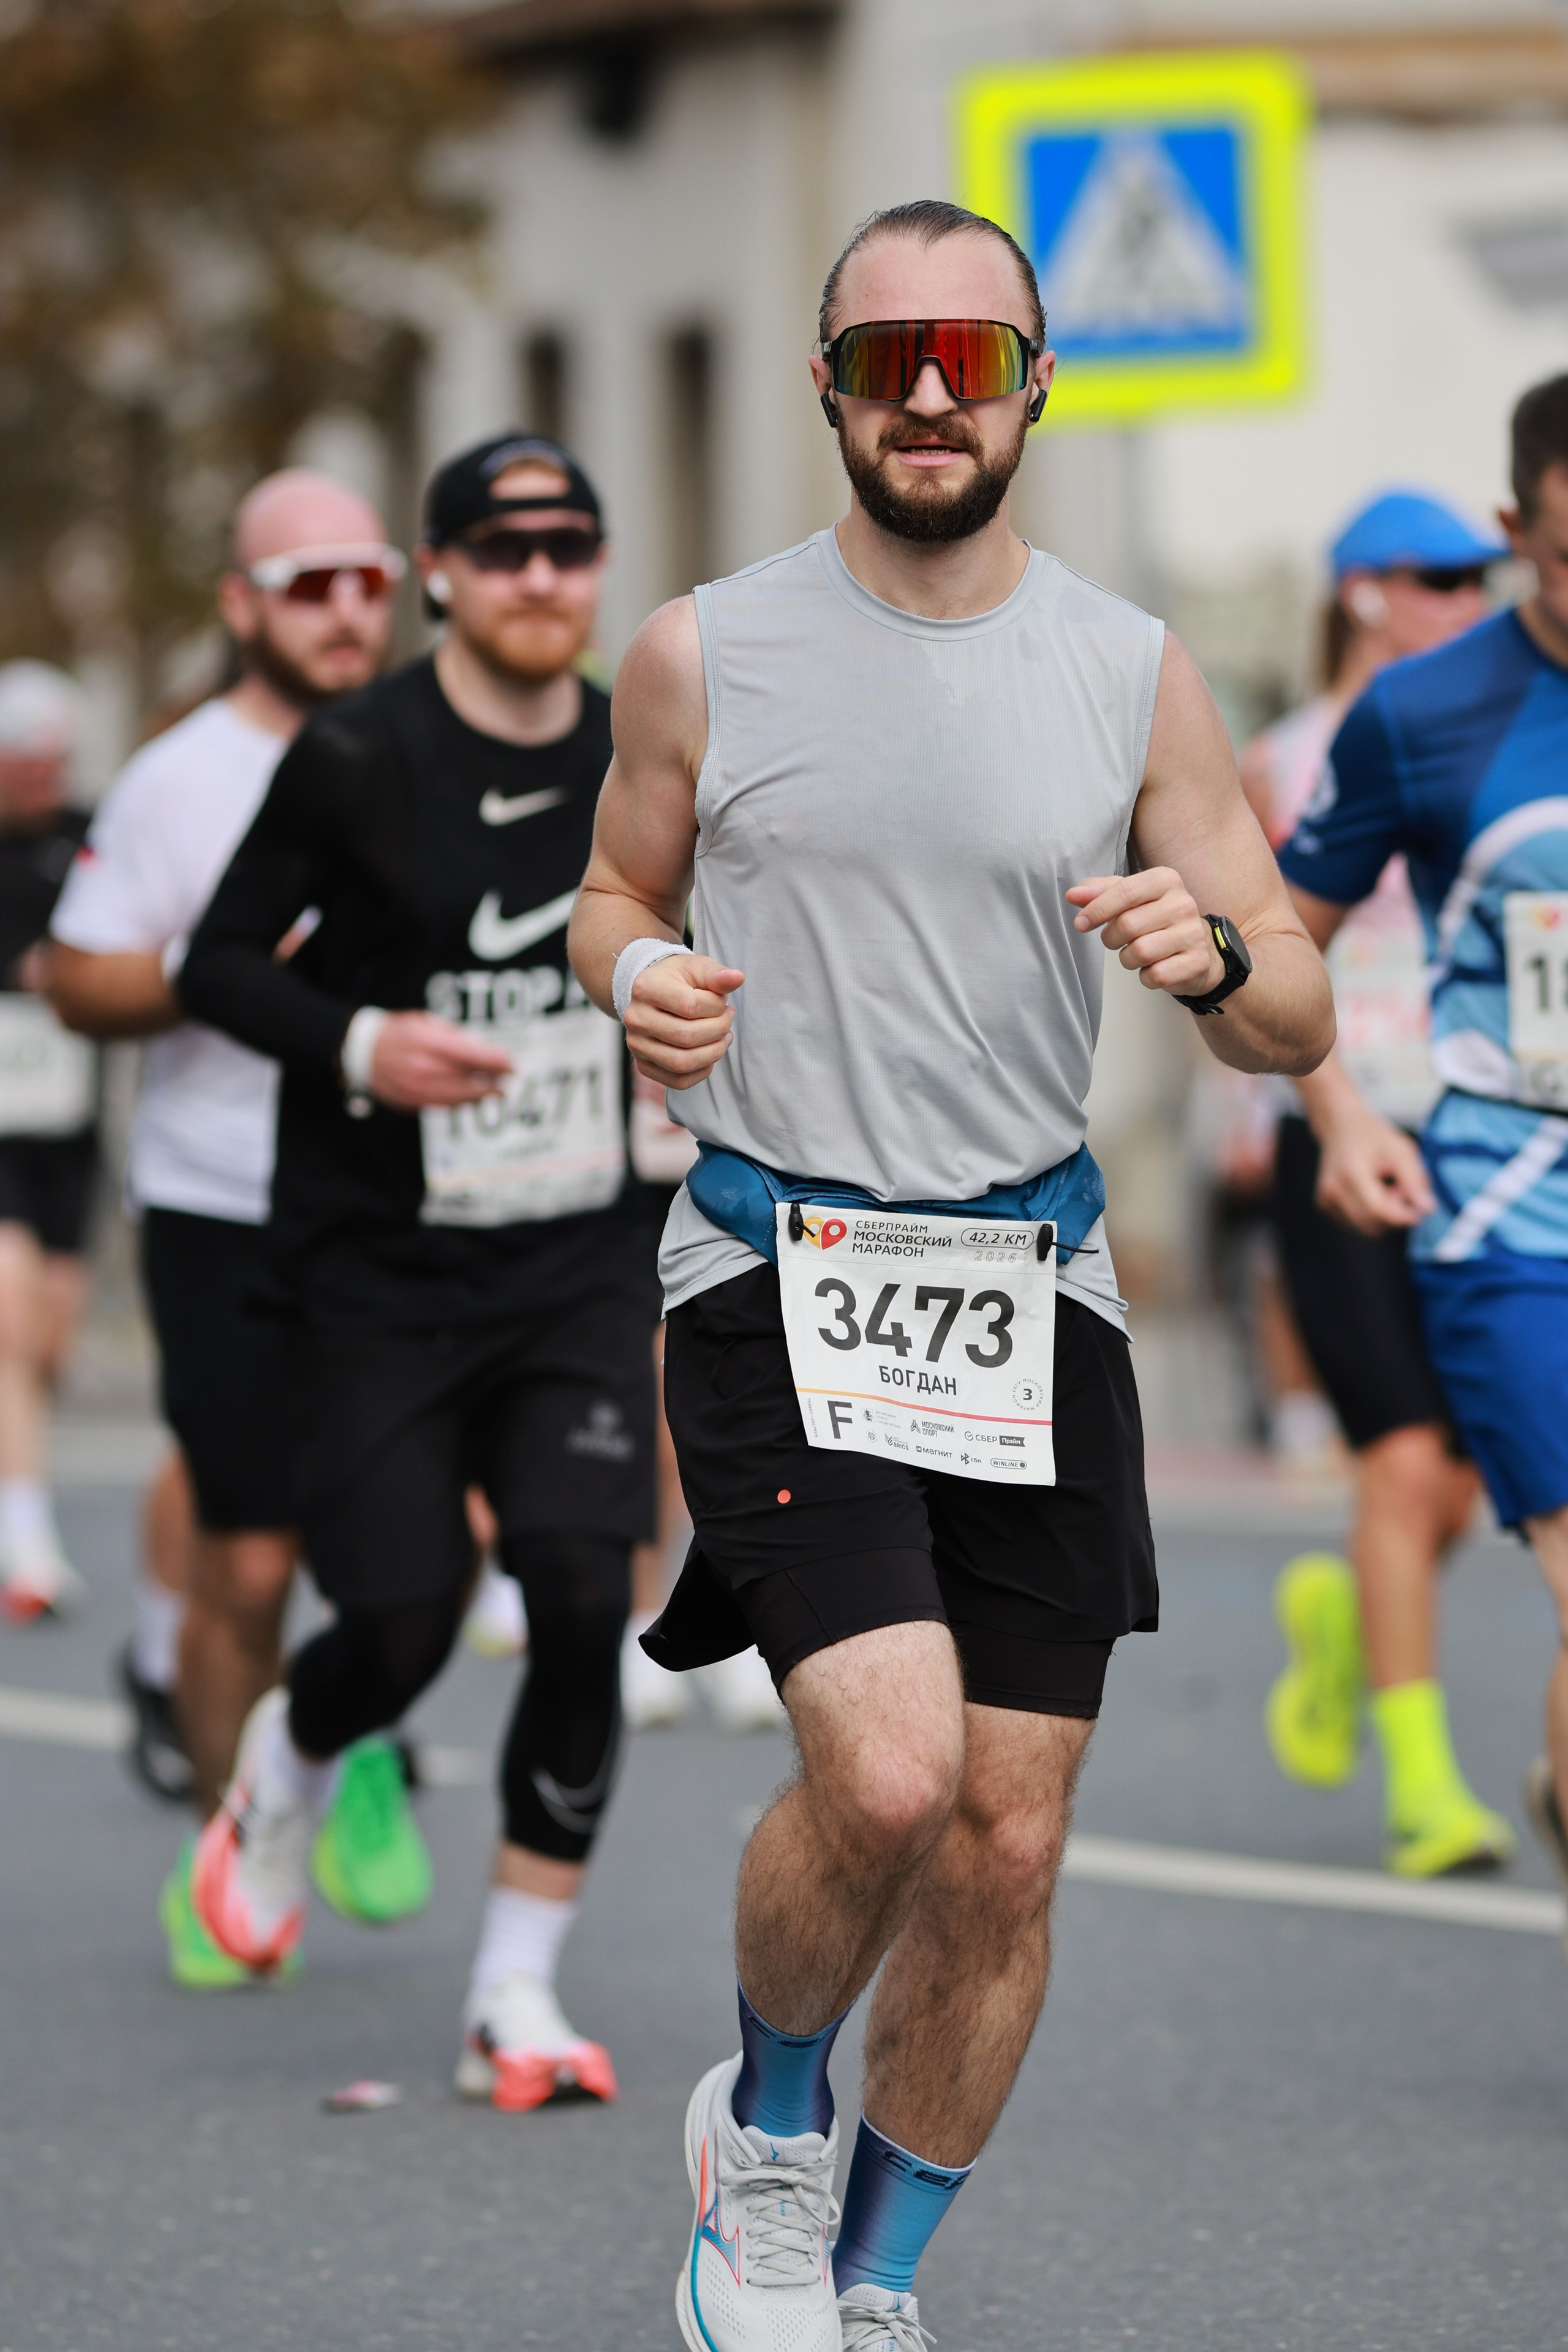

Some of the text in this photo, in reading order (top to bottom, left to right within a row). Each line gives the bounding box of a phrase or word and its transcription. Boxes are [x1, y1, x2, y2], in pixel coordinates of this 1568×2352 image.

[856, 1220, 928, 1234] СБЕРПРАЙМ
[853, 1231, 952, 1247] МОСКОВСКИЙ
[969, 1232, 1000, 1245] 42,2
[852, 1243, 924, 1257] МАРАФОН
[974, 1251, 1017, 1263] 2026
[815, 1278, 1015, 1368] 3473
[878, 1365, 957, 1396] БОГДАН
[1023, 1388, 1033, 1401] 3
[827, 1400, 853, 1439] F
[921, 1420, 954, 1433] МОСКОВСКИЙ
[922, 1428, 938, 1438] СПОРТ
[975, 1434, 998, 1443] СБЕР
[893, 1442, 909, 1450] BRICS
